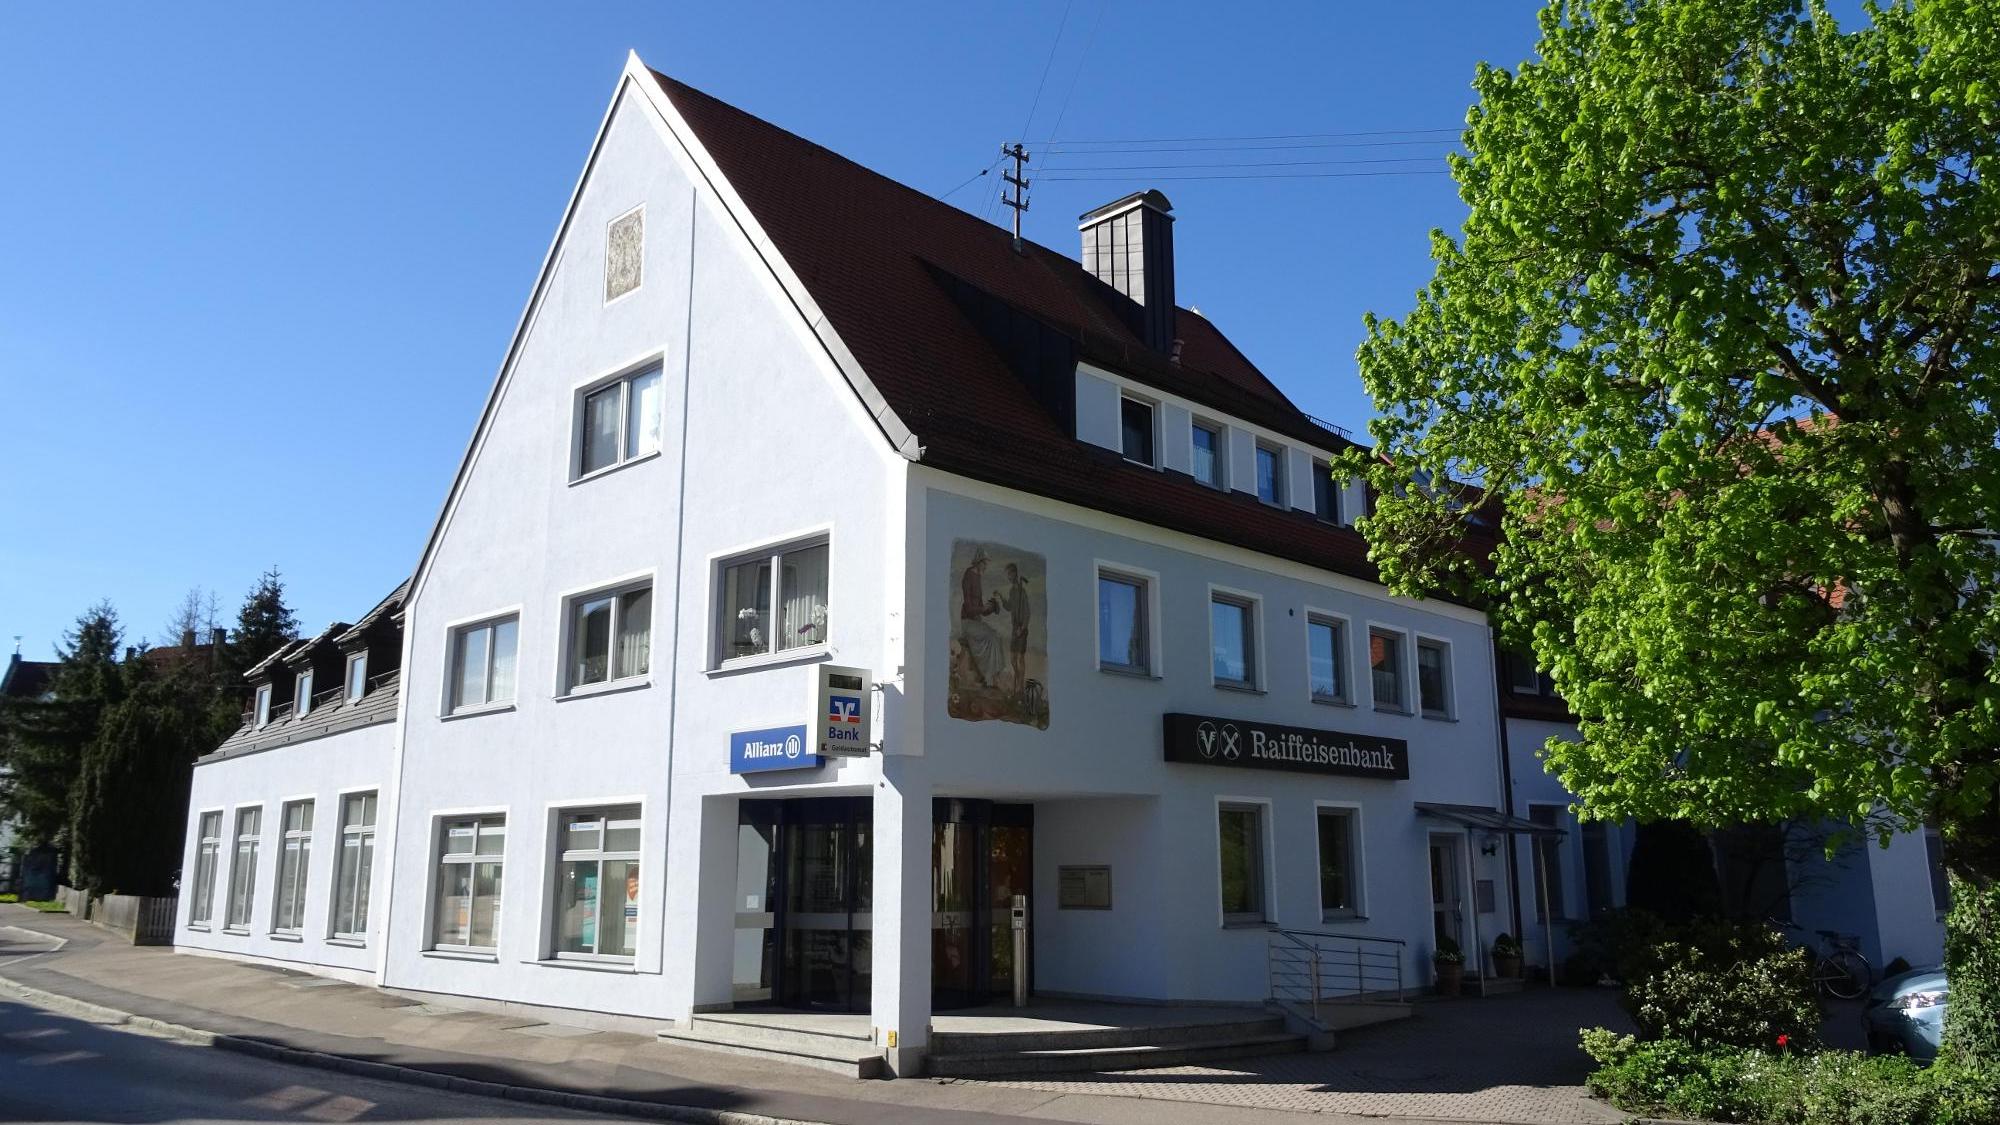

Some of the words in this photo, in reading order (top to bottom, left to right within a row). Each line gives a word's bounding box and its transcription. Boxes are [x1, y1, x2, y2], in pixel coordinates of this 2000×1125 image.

[828, 726, 859, 741] Bank
[744, 740, 783, 759] Allianz
[1250, 730, 1395, 770] Raiffeisenbank
